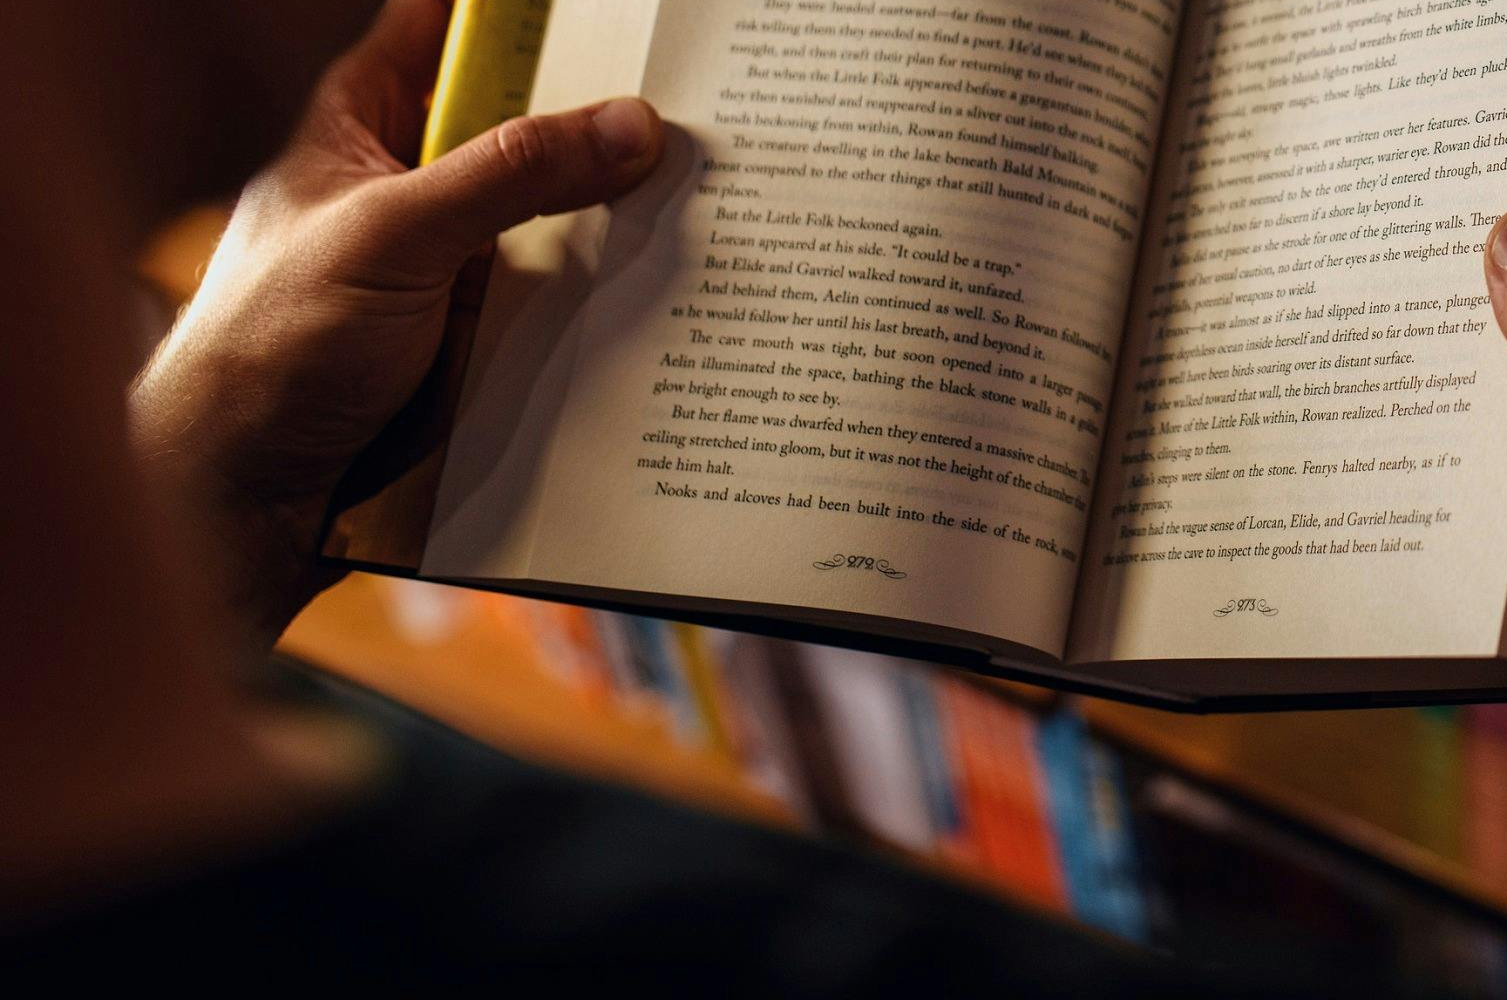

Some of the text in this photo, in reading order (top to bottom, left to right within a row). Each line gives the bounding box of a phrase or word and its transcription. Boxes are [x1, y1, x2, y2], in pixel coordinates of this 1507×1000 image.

[1452, 63, 1477, 81] been
[1390, 166, 1431, 185] entered
[1434, 161, 1482, 180] through,
[1485, 156, 1507, 173] and
[709, 230, 755, 247] Lorcan
[758, 238, 816, 253] appeared
[818, 242, 832, 252] at
[834, 239, 854, 254] his
[857, 241, 886, 257] side.
[911, 248, 950, 264] could
[952, 250, 970, 267] be
[972, 258, 980, 269] a
[698, 279, 729, 295] And
[731, 282, 777, 298] behind
[780, 285, 818, 303] them,
[822, 288, 859, 305] Aelin
[863, 295, 931, 313] continued
[935, 303, 951, 316] as
[953, 305, 986, 321] well.
[992, 308, 1010, 325] So
[1326, 300, 1366, 321] slipped
[1367, 300, 1391, 316] into
[1393, 302, 1400, 312] a
[1404, 299, 1442, 312] trance,
[1274, 318, 1487, 348] herself and drifted so far down that they
[689, 328, 713, 344] The
[718, 335, 746, 347] cave
[752, 336, 794, 351] mouth
[800, 341, 825, 352] was
[831, 341, 867, 359] tight,
[873, 343, 897, 360] but
[901, 351, 935, 365] soon
[941, 356, 992, 375] opened
[997, 364, 1024, 380] into
[1284, 370, 1477, 398] the birch branches artfully displayed
[1262, 397, 1471, 425] within, Rowan realized. Perched on the
[671, 404, 696, 420] But
[698, 406, 720, 422] her
[722, 408, 759, 425] flame
[761, 415, 787, 427] was
[788, 413, 844, 432] dwarfed
[846, 419, 883, 437] when
[887, 423, 919, 445] they
[919, 431, 973, 450] entered
[973, 441, 984, 452] a
[1204, 452, 1461, 481] silent on the stone. Fenrys halted nearby, as if to
[654, 480, 698, 499] Nooks
[703, 486, 729, 501] and
[733, 488, 781, 506] alcoves
[786, 492, 813, 508] had
[818, 495, 850, 513] been
[856, 499, 891, 517] built
[896, 504, 925, 522] into
[931, 510, 958, 528] the
[958, 516, 991, 535] side
[992, 523, 1010, 541] of
[1247, 507, 1451, 531] Lorcan, Elide, and Gavriel heading for
[847, 555, 875, 570] 272
[1237, 598, 1257, 612] 273
